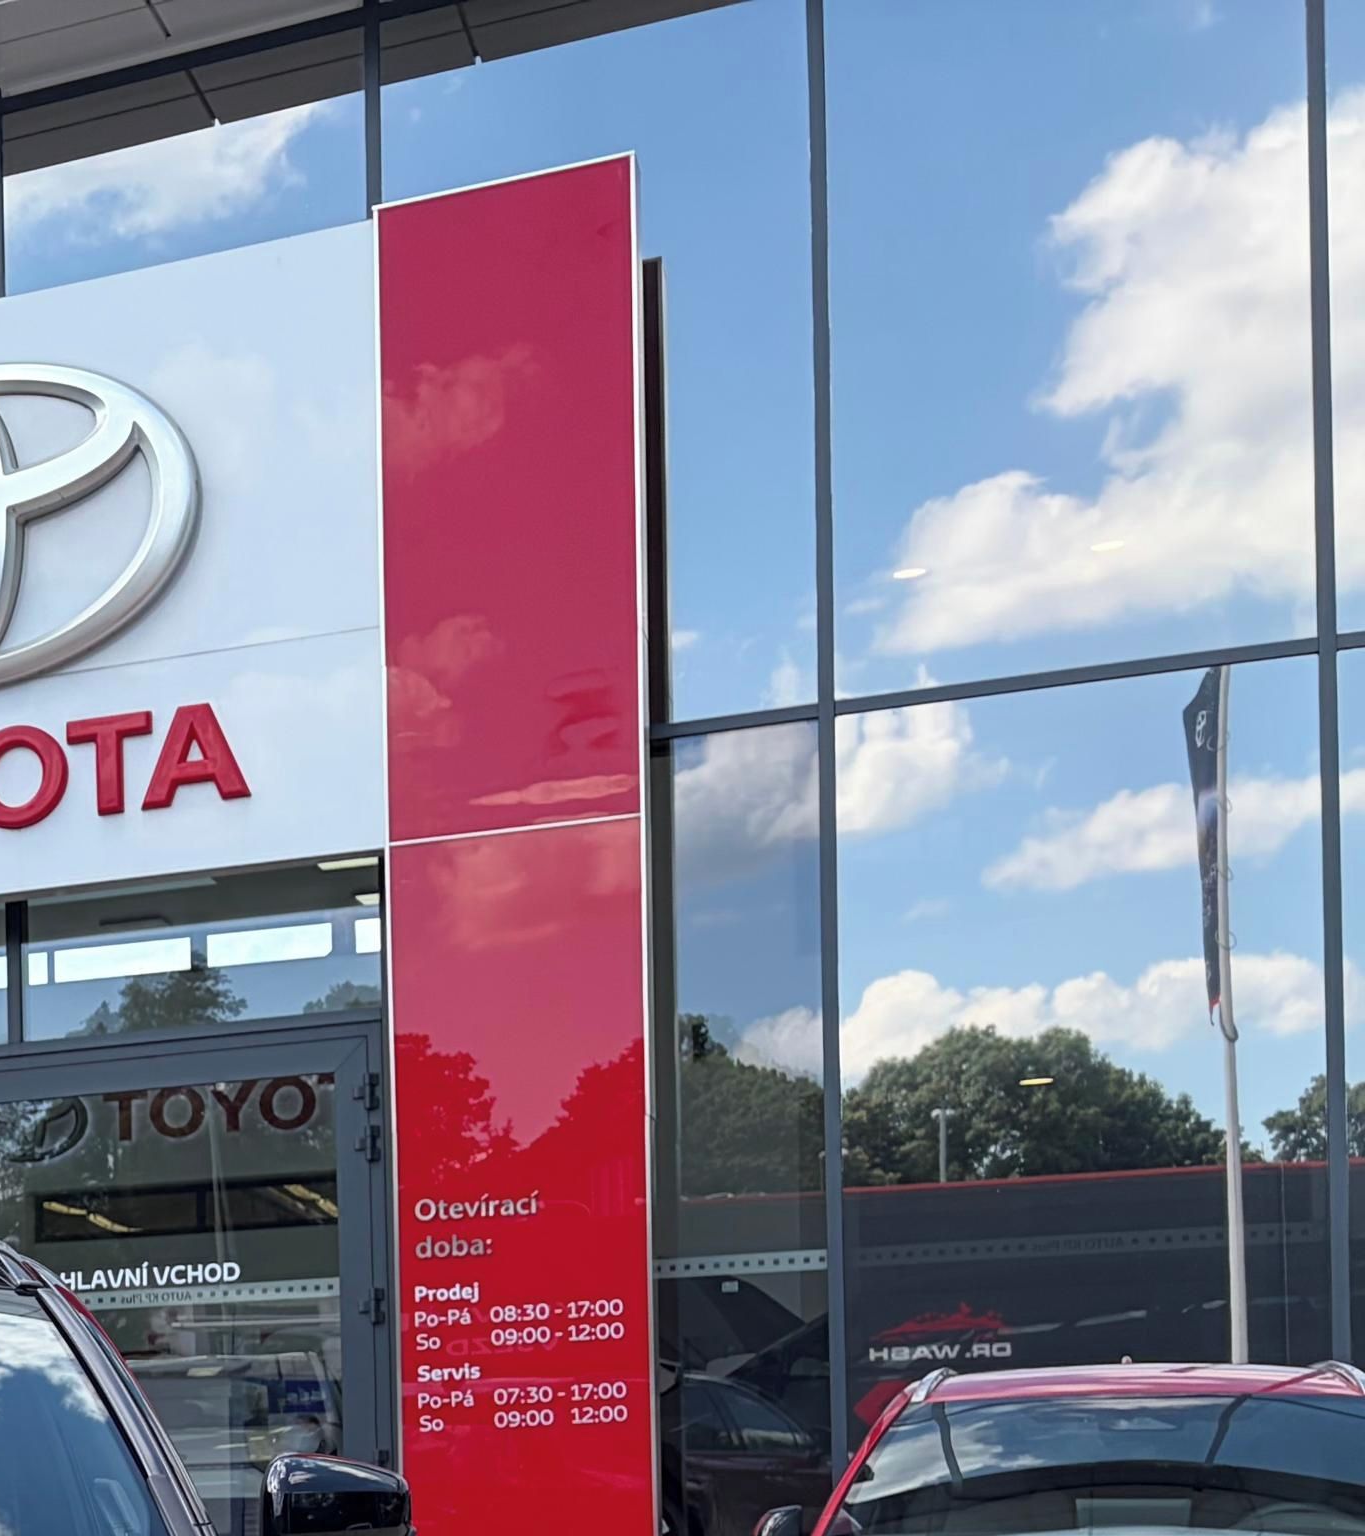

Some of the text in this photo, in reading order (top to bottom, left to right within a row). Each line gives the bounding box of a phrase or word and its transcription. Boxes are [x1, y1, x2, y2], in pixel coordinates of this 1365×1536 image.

[102, 1072, 335, 1142] TOYO
[414, 1190, 539, 1221] Otevírací
[415, 1234, 493, 1259] doba:
[152, 1262, 240, 1287] VCHOD
[414, 1282, 480, 1303] Prodej
[414, 1308, 471, 1327] Po-Pá
[490, 1303, 550, 1323] 08:30
[567, 1298, 624, 1319] 17:00
[416, 1333, 441, 1350] So
[491, 1326, 551, 1346] 09:00
[568, 1322, 625, 1342] 12:00
[417, 1363, 481, 1383] Servis
[418, 1390, 475, 1409] Po-Pá
[493, 1386, 553, 1405] 07:30
[571, 1381, 627, 1401] 17:00
[419, 1405, 628, 1432] So 09:00 12:00
